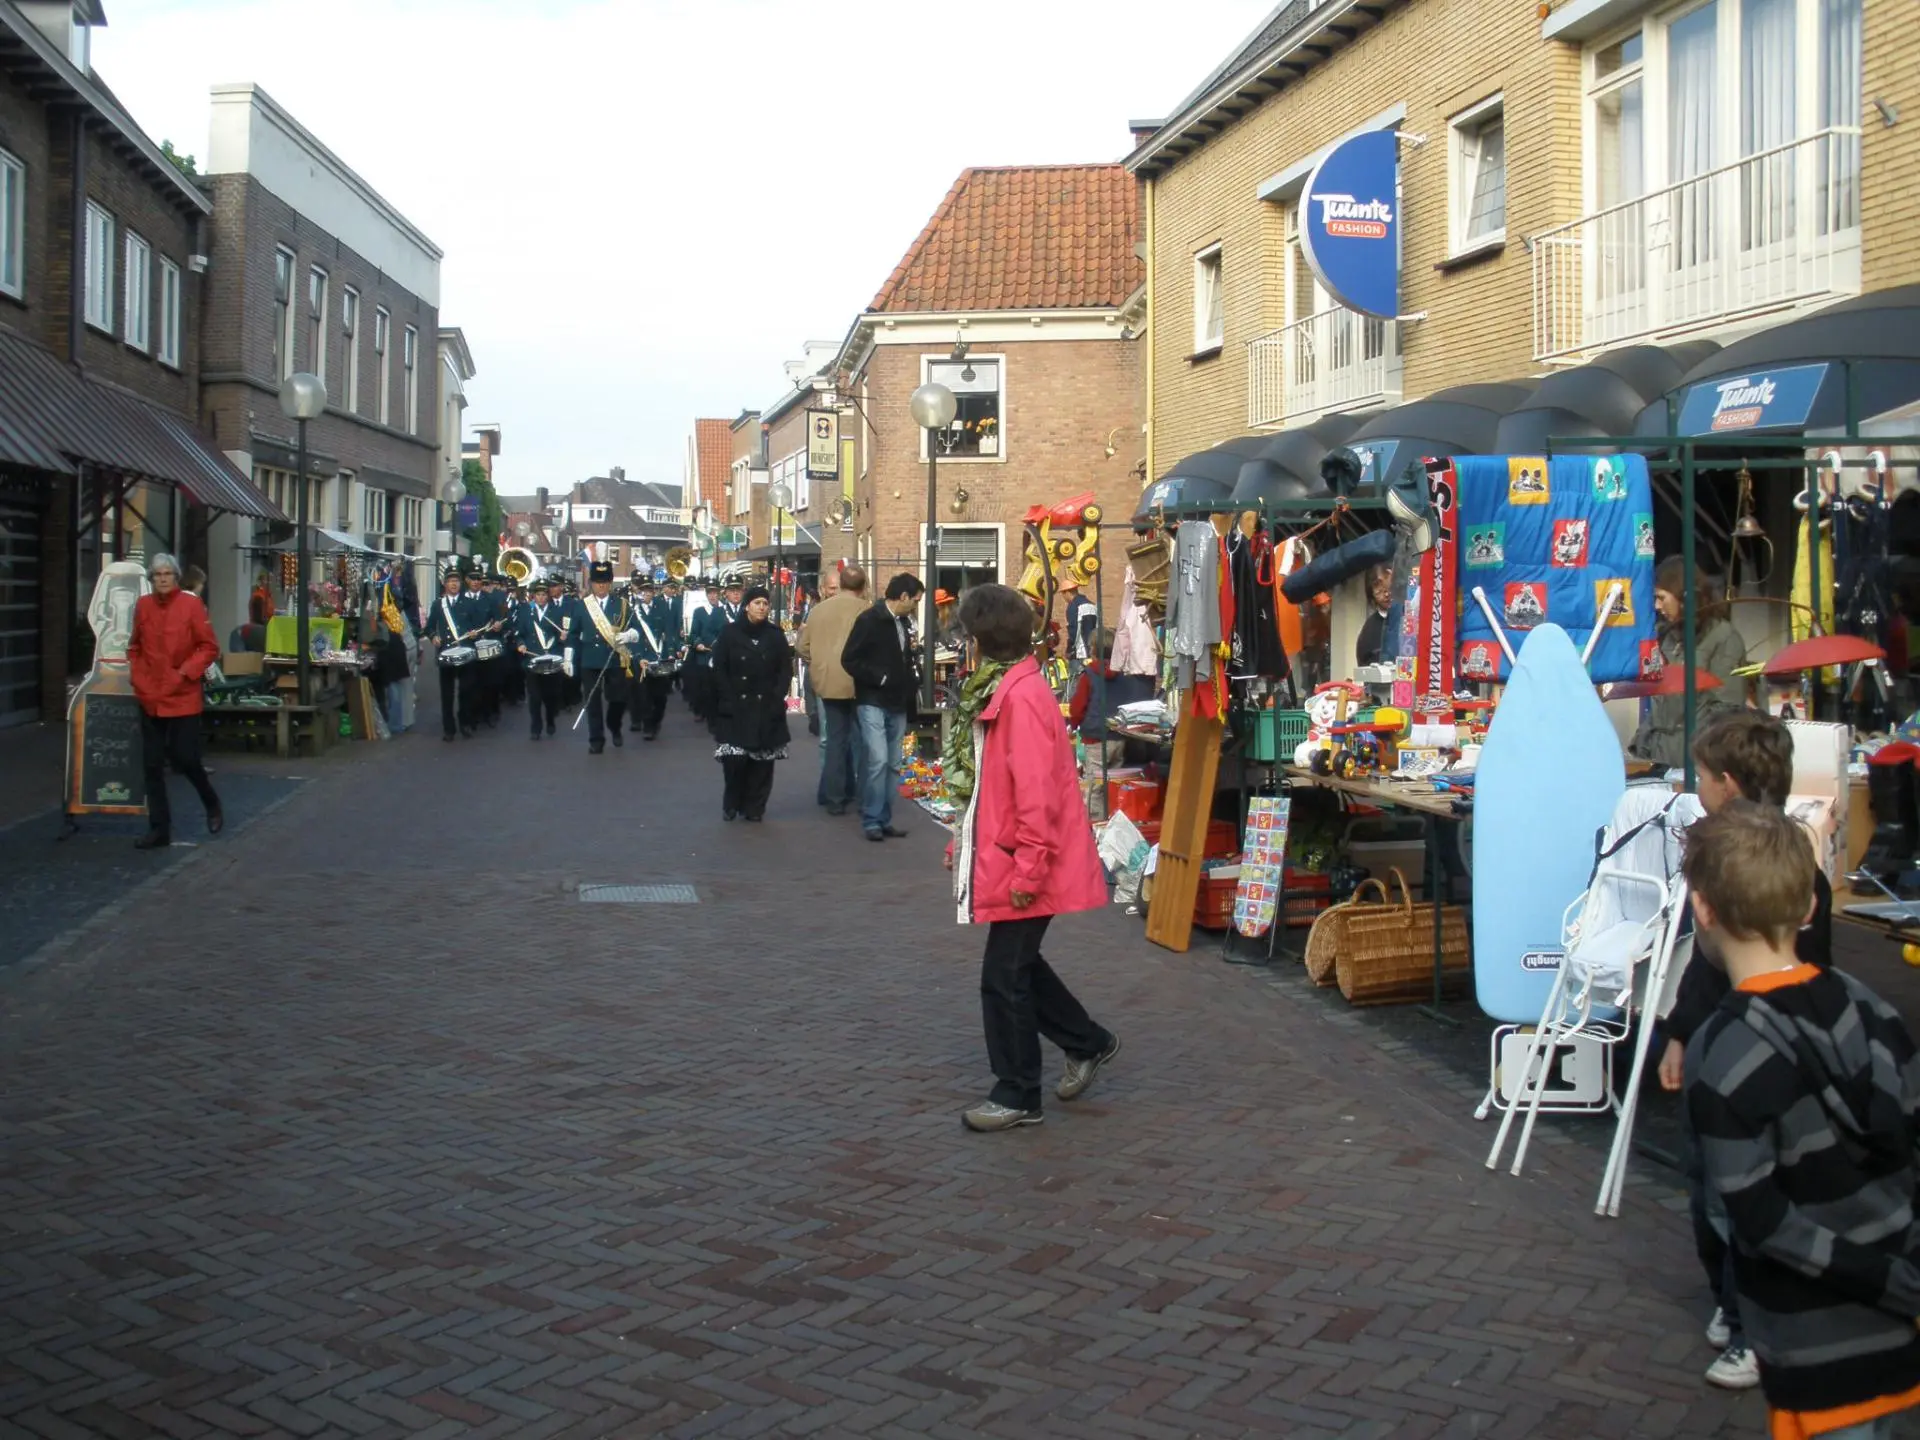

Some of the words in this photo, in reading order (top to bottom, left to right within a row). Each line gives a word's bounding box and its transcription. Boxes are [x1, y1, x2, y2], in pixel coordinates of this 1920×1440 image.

[1311, 194, 1393, 223] Tuunte
[1332, 224, 1381, 235] FASHION
[1712, 378, 1776, 418] Tuunte
[1717, 413, 1758, 425] FASHION
